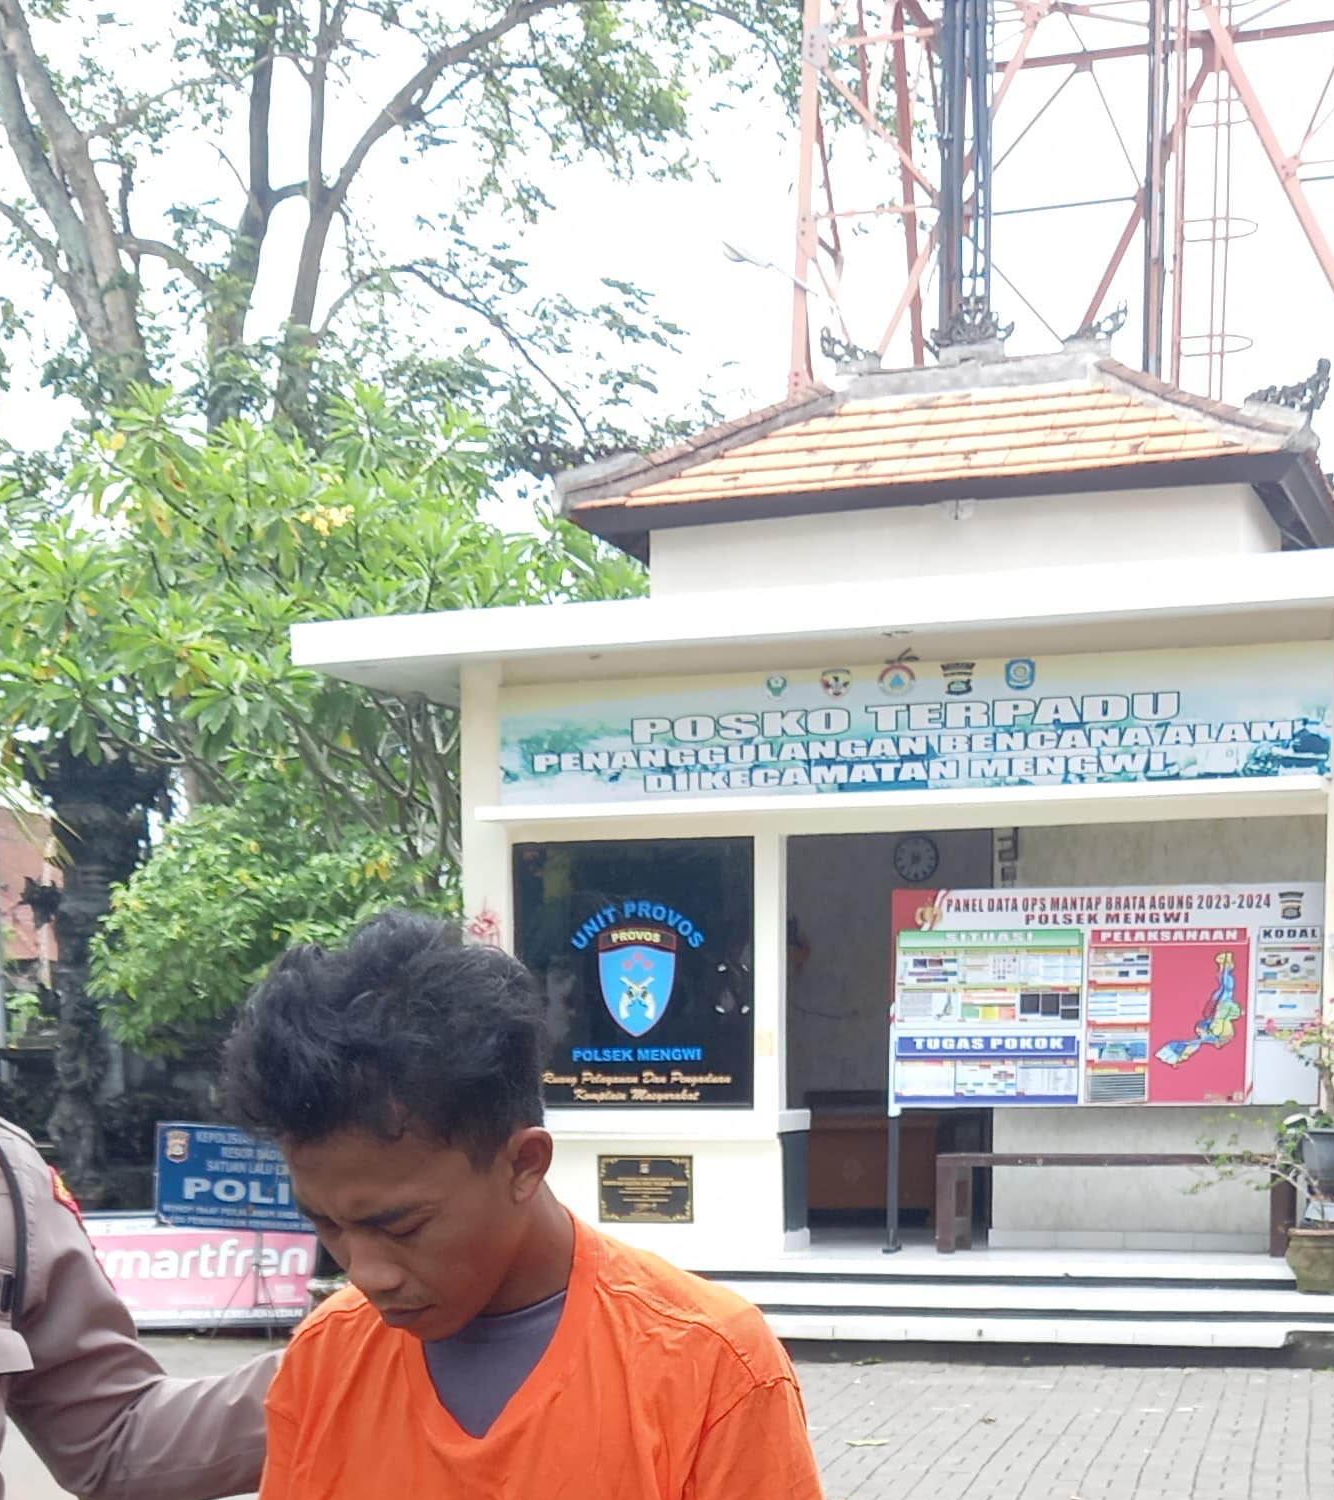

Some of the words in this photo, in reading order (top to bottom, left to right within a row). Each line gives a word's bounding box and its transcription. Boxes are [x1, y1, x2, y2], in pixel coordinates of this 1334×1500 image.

[630, 707, 851, 744] POSKO
[866, 691, 1180, 733] TERPADU
[533, 735, 928, 772] PENANGGULANGAN
[939, 726, 1152, 755] BENCANA
[1162, 719, 1294, 746] ALAM
[644, 771, 689, 793] DI
[691, 760, 959, 791] KECAMATAN
[969, 750, 1168, 779] MENGWI
[946, 898, 984, 912] PANEL
[987, 898, 1018, 912] DATA
[1022, 897, 1046, 911] OPS
[1050, 896, 1102, 911] MANTAP
[1105, 895, 1146, 910] BRATA
[1149, 895, 1193, 909] AGUNG
[1197, 894, 1271, 909] 2023-2024
[570, 907, 618, 950] UNIT
[622, 901, 706, 949] PROVOS
[1025, 913, 1099, 925] POLSEK
[1105, 912, 1190, 924] MENGWI
[611, 930, 662, 944] PROVOS
[945, 931, 1035, 944] SITUASI
[1100, 929, 1238, 942] PELAKSANAAN
[1262, 928, 1318, 939] KODAL
[913, 1037, 985, 1050] TUGAS
[990, 1037, 1064, 1050] POKOK
[572, 1048, 634, 1062] POLSEK
[636, 1047, 702, 1061] MENGWI
